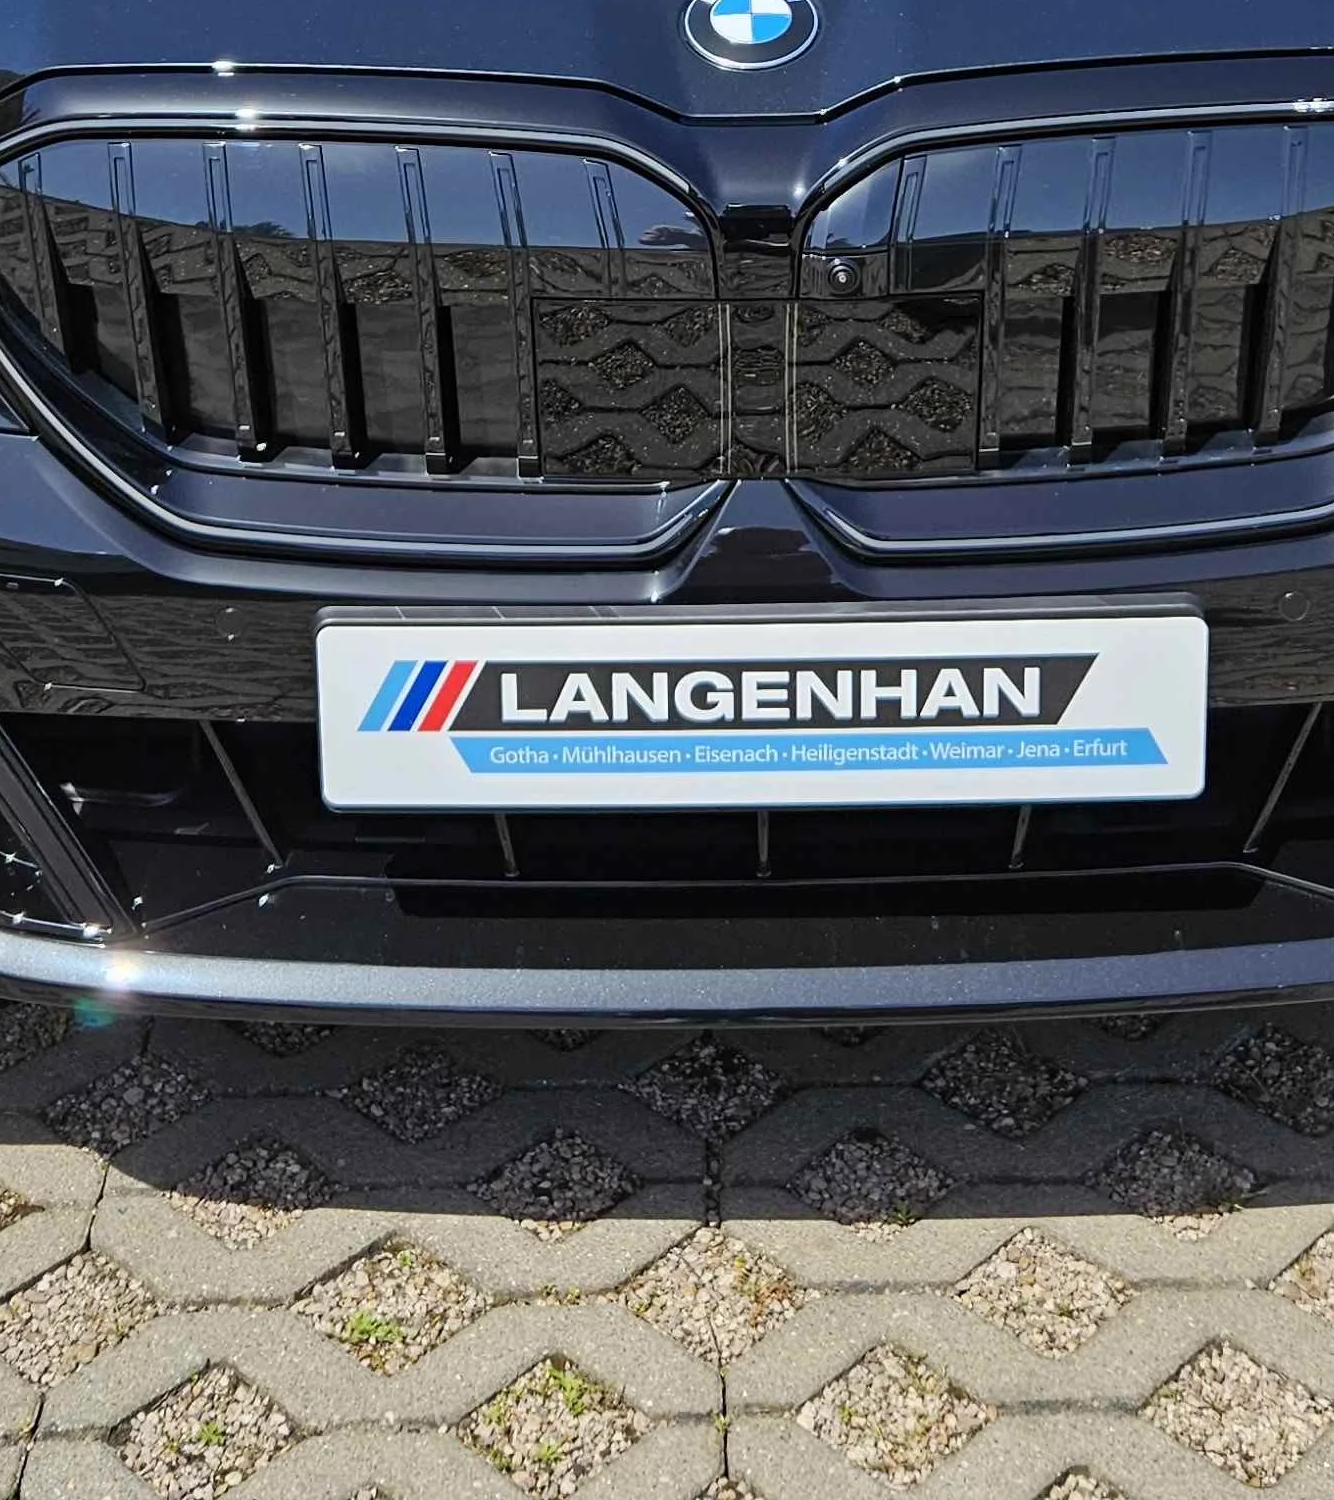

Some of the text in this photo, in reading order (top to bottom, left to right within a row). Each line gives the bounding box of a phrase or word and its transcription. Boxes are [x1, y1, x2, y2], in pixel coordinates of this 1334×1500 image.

[500, 666, 1041, 724] LANGENHAN
[489, 738, 1128, 766] Gotha Mühlhausen Eisenach Heiligenstadt Weimar Jena Erfurt
